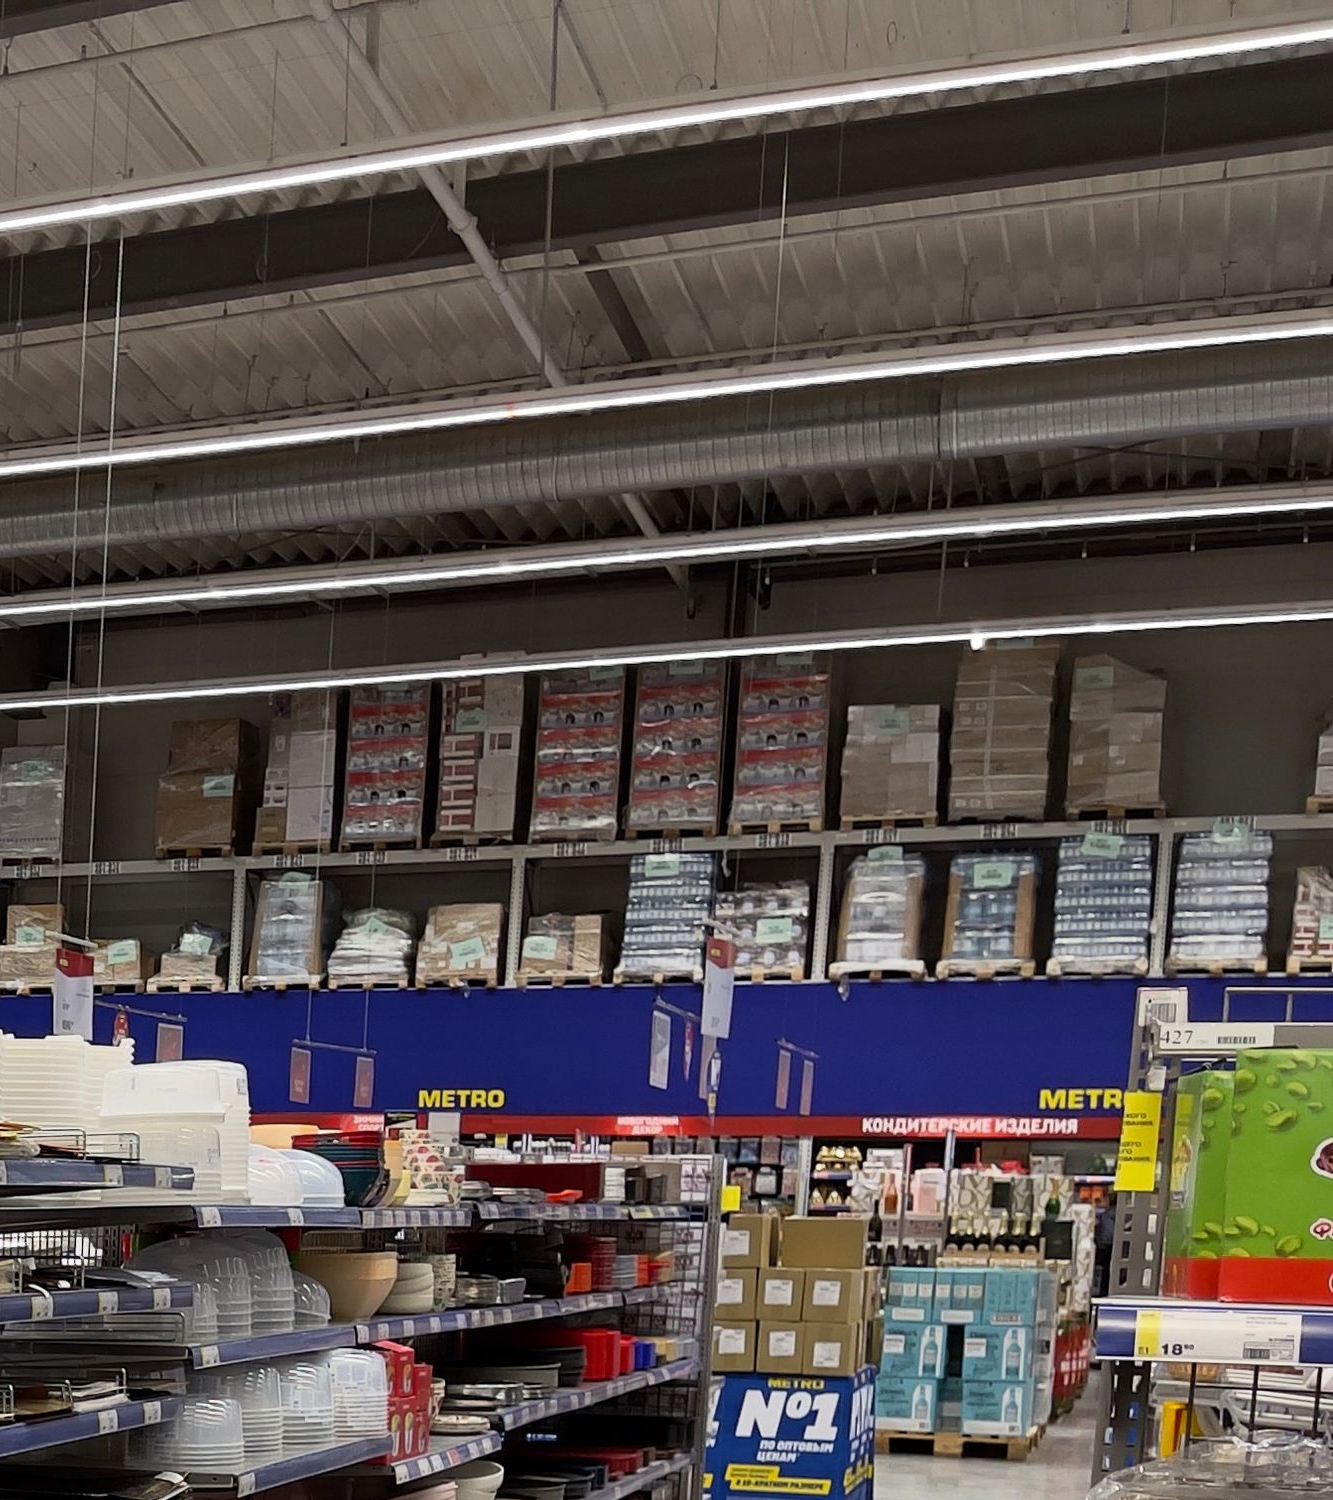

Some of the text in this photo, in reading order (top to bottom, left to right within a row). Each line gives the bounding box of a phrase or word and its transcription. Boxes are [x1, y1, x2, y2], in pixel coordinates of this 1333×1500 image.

[418, 1089, 505, 1109] METRO
[1039, 1089, 1126, 1110] METR
[862, 1118, 1078, 1136] КОНДИТЕРСКИЕ ИЗДЕЛИЯ
[759, 1439, 835, 1454] ПО ОПТОВЫМ
